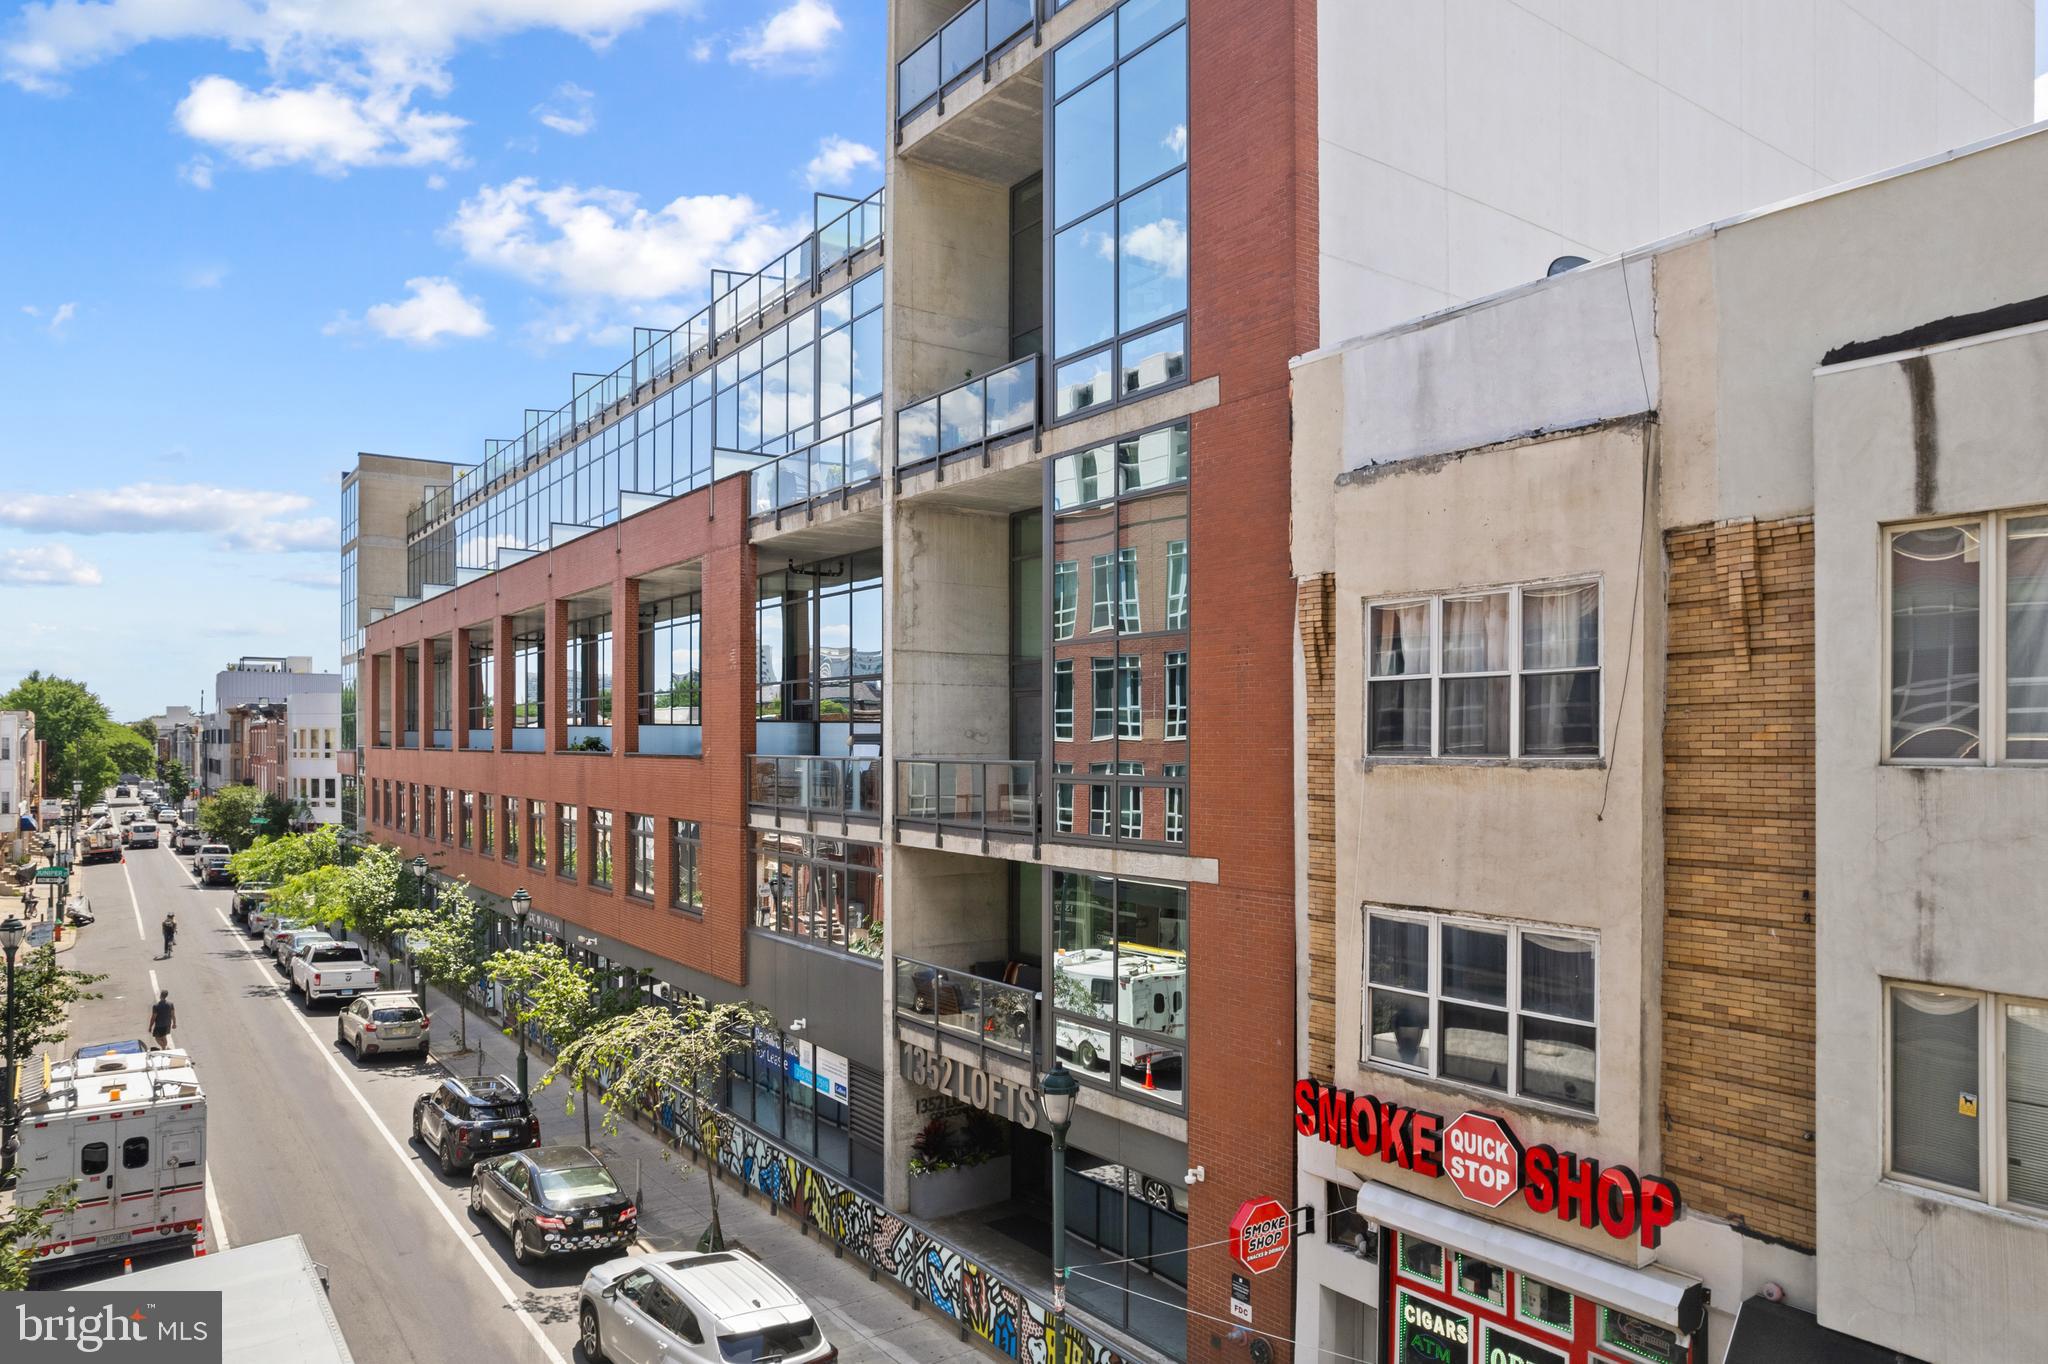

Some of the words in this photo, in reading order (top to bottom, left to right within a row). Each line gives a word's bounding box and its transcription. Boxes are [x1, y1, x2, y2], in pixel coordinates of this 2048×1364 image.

[904, 1044, 953, 1097] 1352
[958, 1062, 1037, 1129] LOFTS
[1295, 1078, 1444, 1178] SMOKE
[1524, 1144, 1681, 1250] SHOP
[1450, 1128, 1509, 1165] QUICK
[1450, 1156, 1510, 1191] STOP
[1244, 1215, 1287, 1240] SMOKE
[1248, 1231, 1282, 1253] SHOP
[1234, 1304, 1249, 1317] FDC
[1404, 1304, 1468, 1345] CIGARS
[1410, 1332, 1451, 1364] ATM
